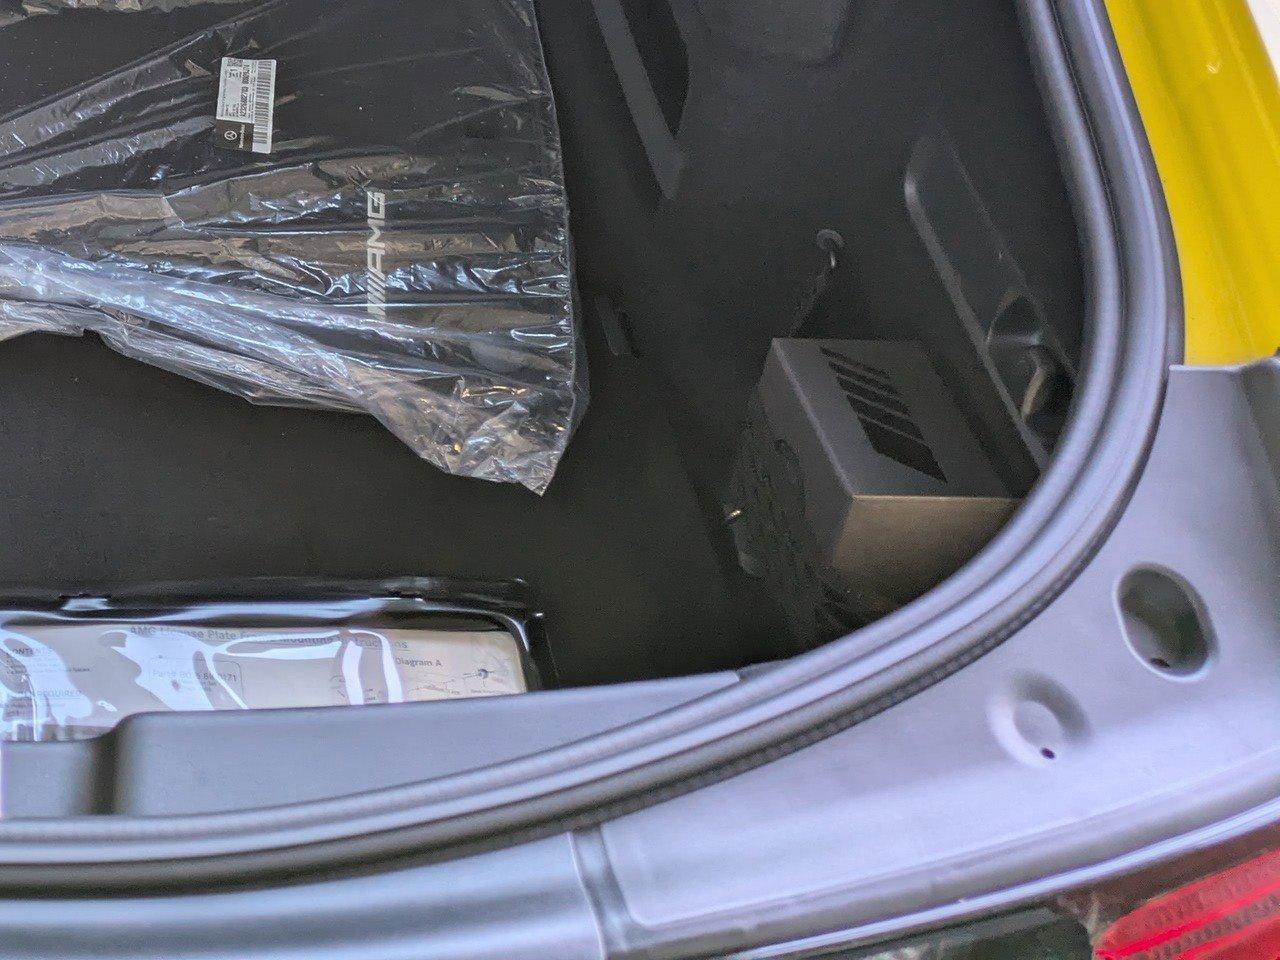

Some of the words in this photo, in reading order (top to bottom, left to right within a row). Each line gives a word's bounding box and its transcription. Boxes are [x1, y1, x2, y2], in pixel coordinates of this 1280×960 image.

[367, 191, 386, 283] AMG
[130, 626, 156, 637] AMG
[207, 629, 237, 640] Plate
[395, 657, 433, 668] Diagram
[436, 658, 443, 667] A
